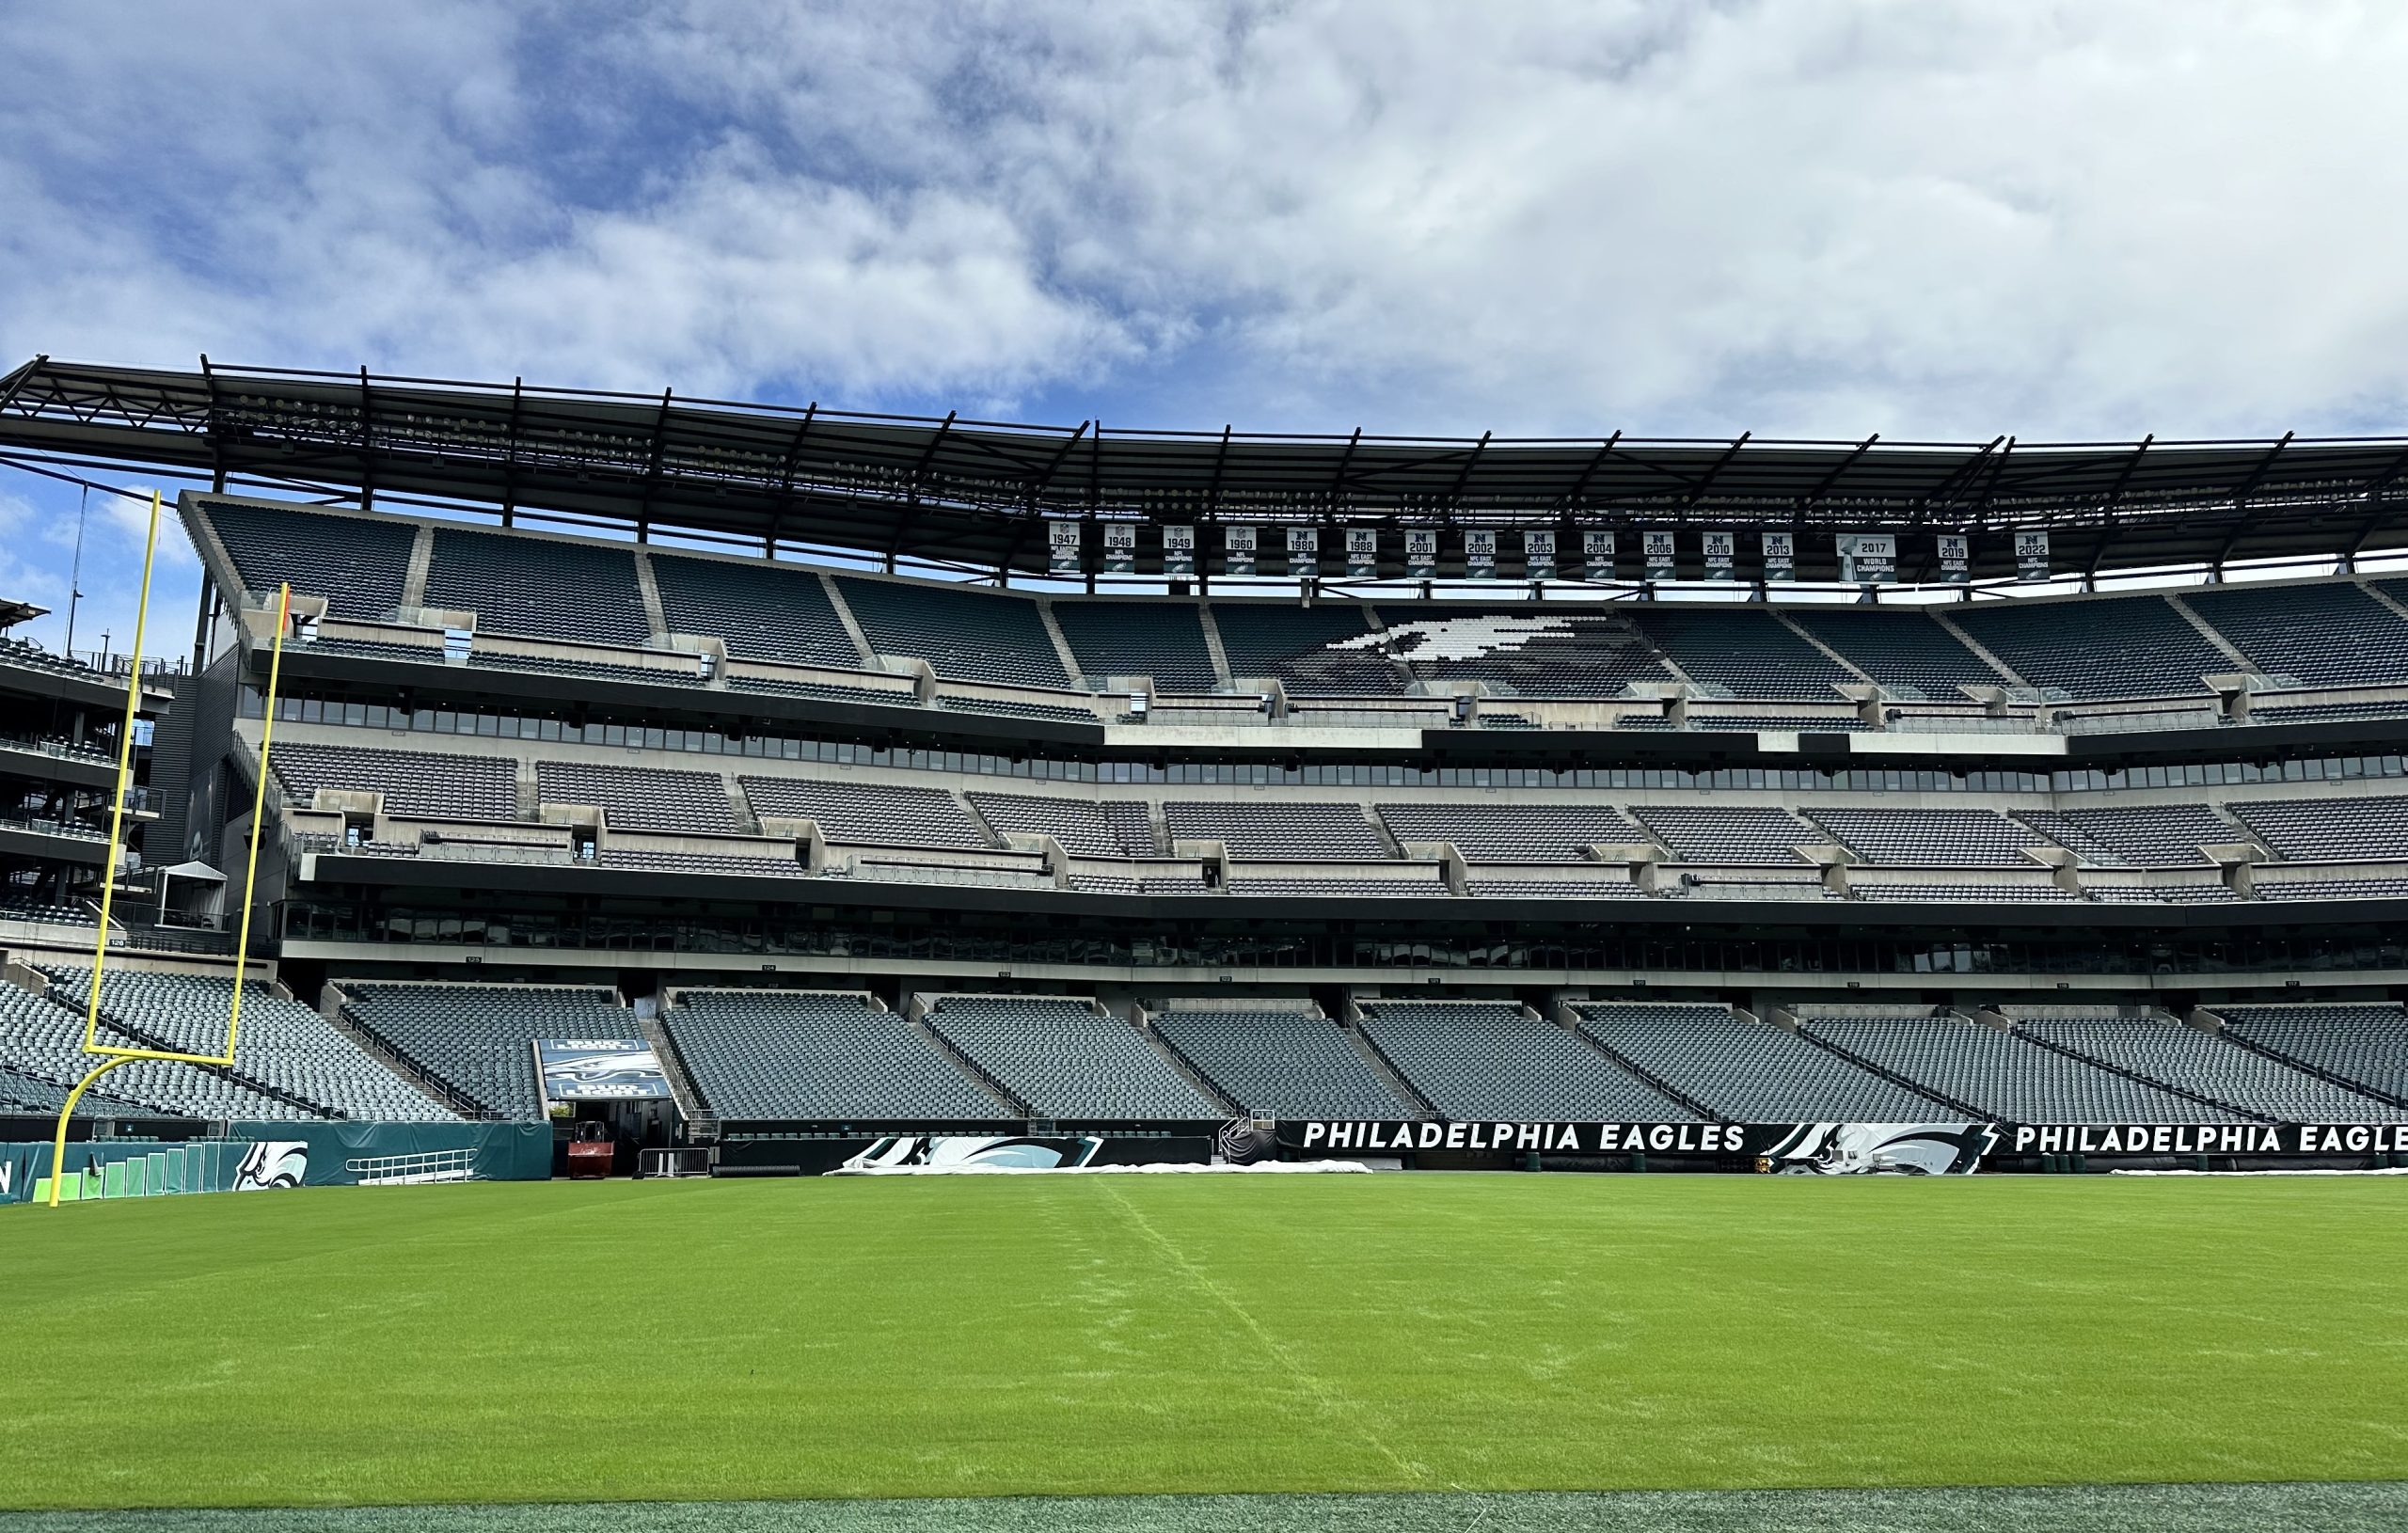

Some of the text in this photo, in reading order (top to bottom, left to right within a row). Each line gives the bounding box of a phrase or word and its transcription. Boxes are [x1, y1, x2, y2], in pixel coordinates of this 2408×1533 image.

[1054, 534, 1076, 545] 1947
[1109, 537, 1132, 546] 1948
[1168, 538, 1190, 548] 1949
[1230, 540, 1252, 549] 1960
[1291, 541, 1314, 550] 1980
[1350, 542, 1372, 550] 1988
[1410, 543, 1432, 552] 2001
[1468, 544, 1493, 553] 2002
[1528, 544, 1552, 553] 2003
[1587, 544, 1611, 553] 2004
[1861, 543, 1886, 553] 2017
[1647, 545, 1671, 554] 2006
[1707, 545, 1729, 554] 2010
[1766, 545, 1789, 555] 2013
[1941, 548, 1964, 558] 2019
[2019, 545, 2046, 554] 2022
[1856, 564, 1895, 573] CHAMPIONS
[1304, 1122, 1744, 1151] PHILADELPHIA EAGLES
[2015, 1126, 2281, 1152] PHILADELPHIA
